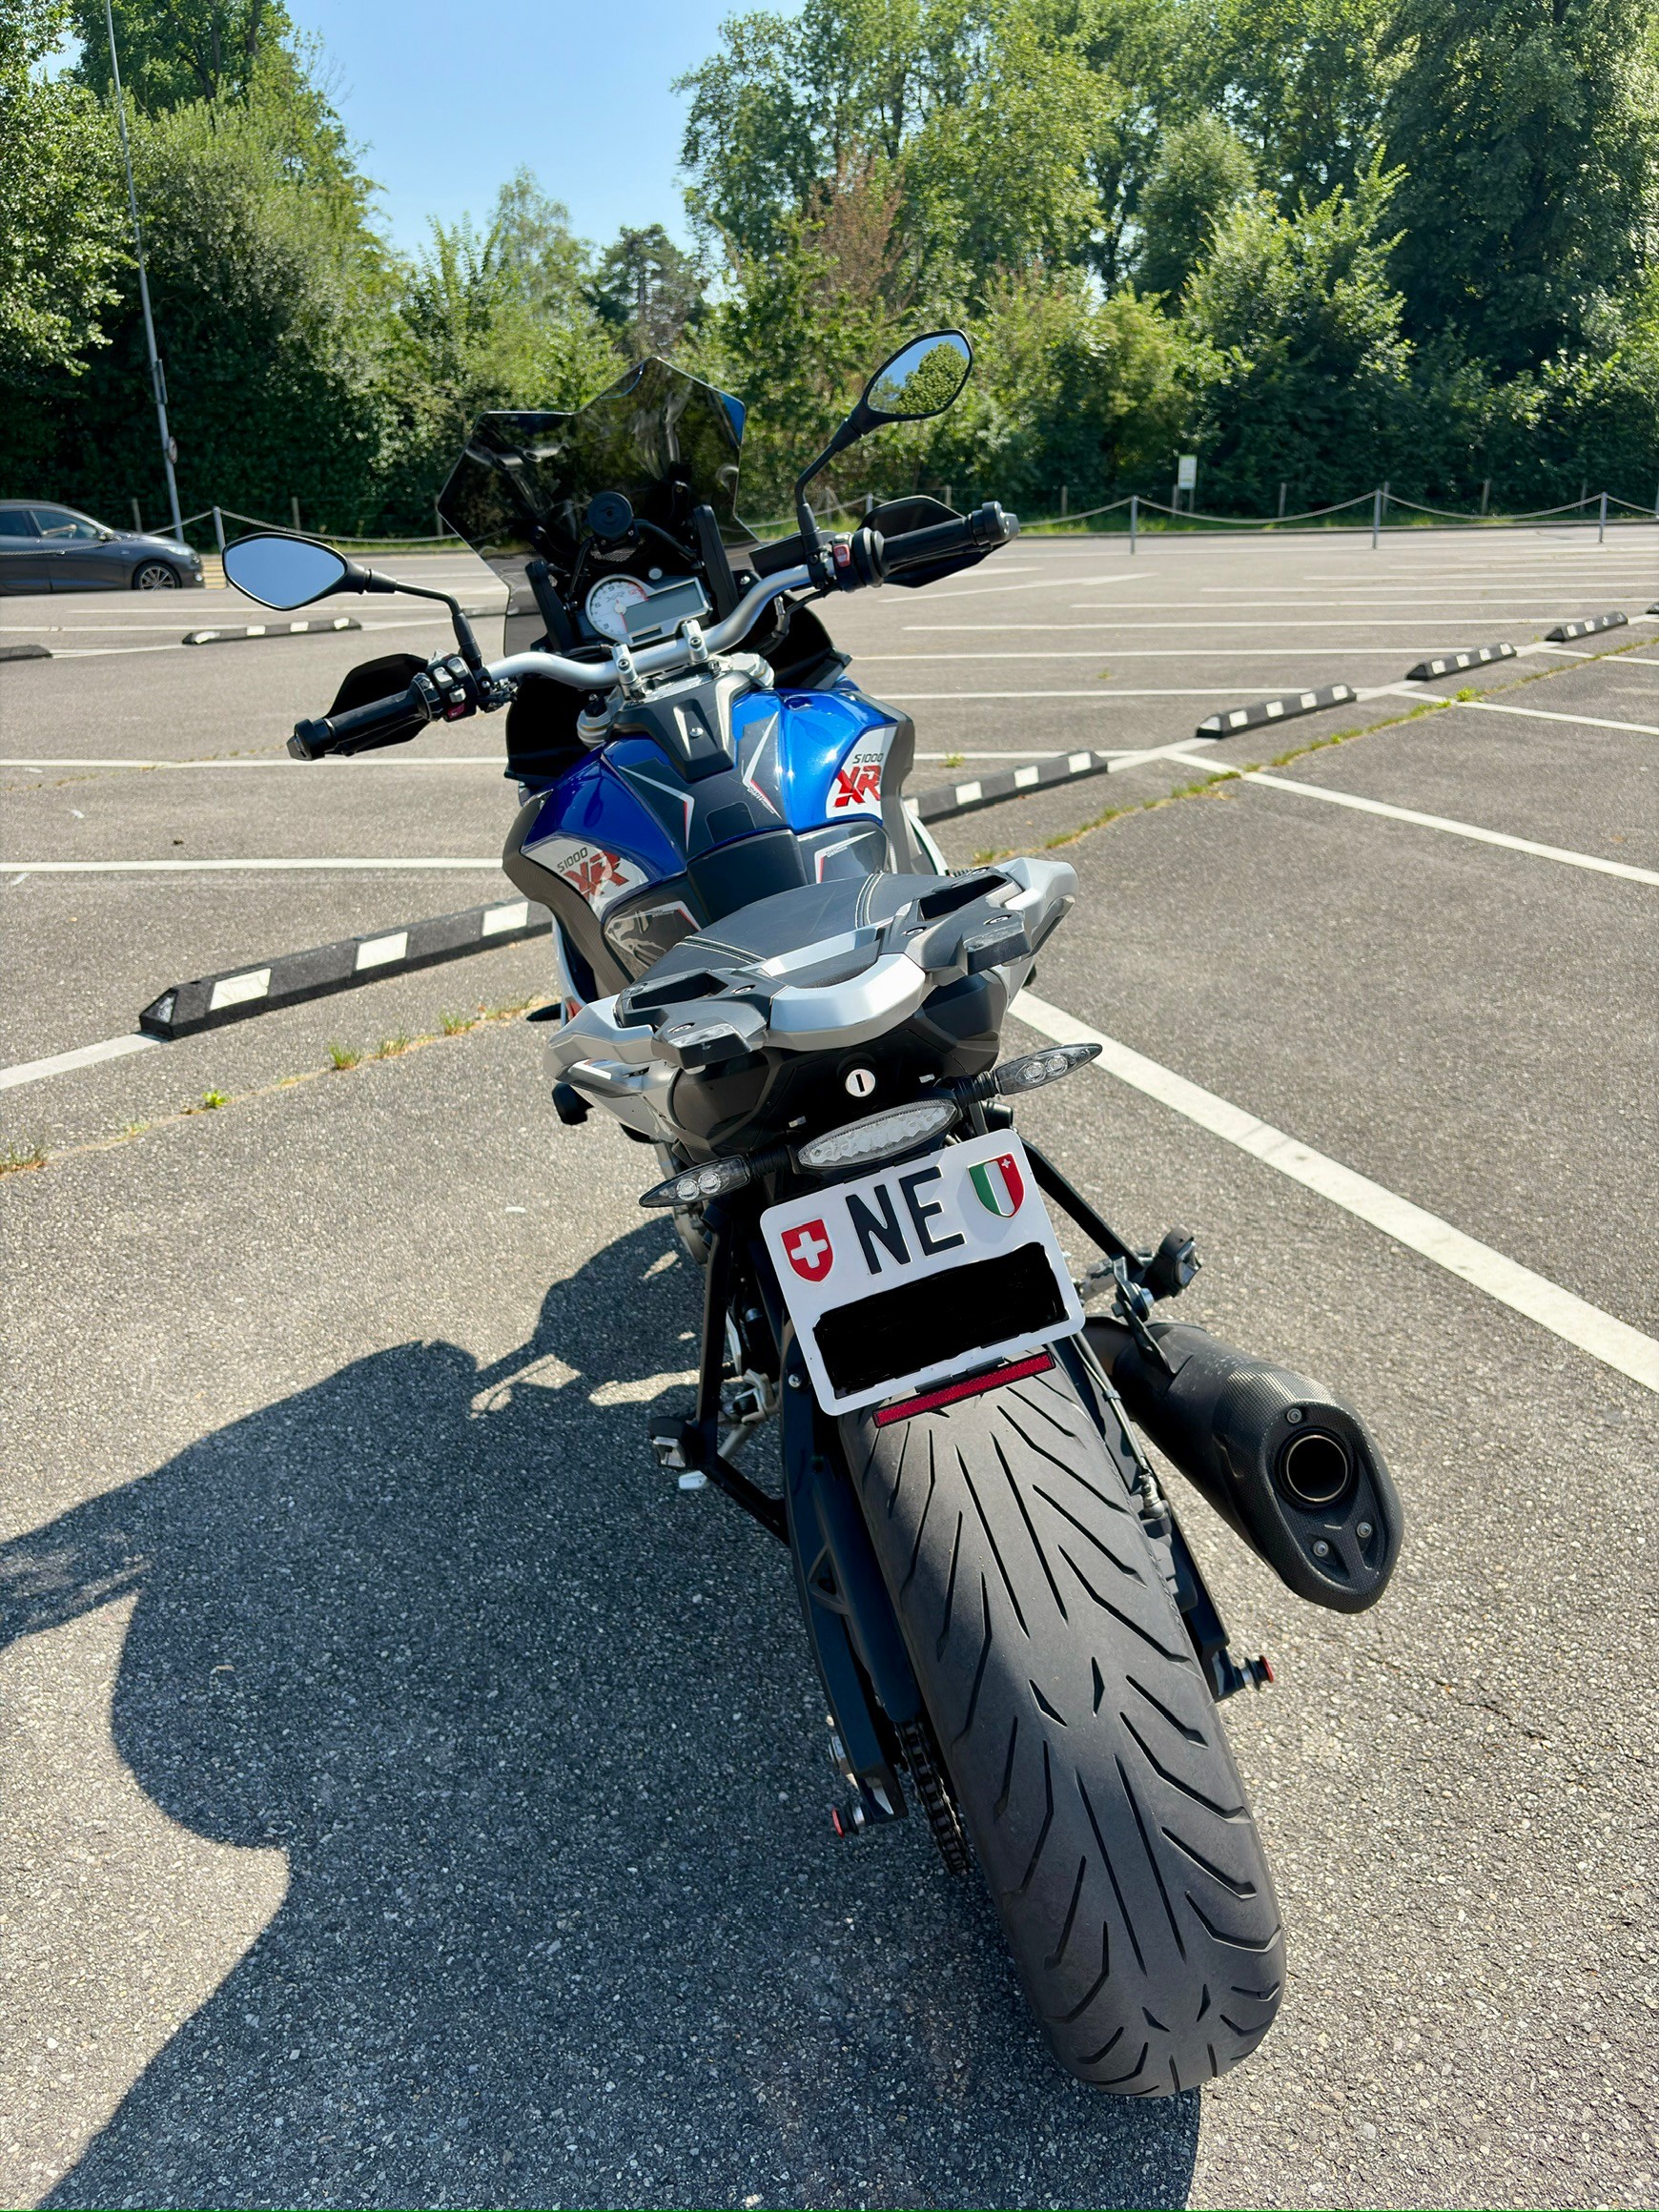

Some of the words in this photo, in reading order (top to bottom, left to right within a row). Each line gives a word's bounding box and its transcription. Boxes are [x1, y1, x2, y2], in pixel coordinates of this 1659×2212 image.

[852, 752, 884, 764] S1000
[833, 765, 882, 808] XR
[557, 847, 588, 873] S1000
[845, 1165, 966, 1275] NE
